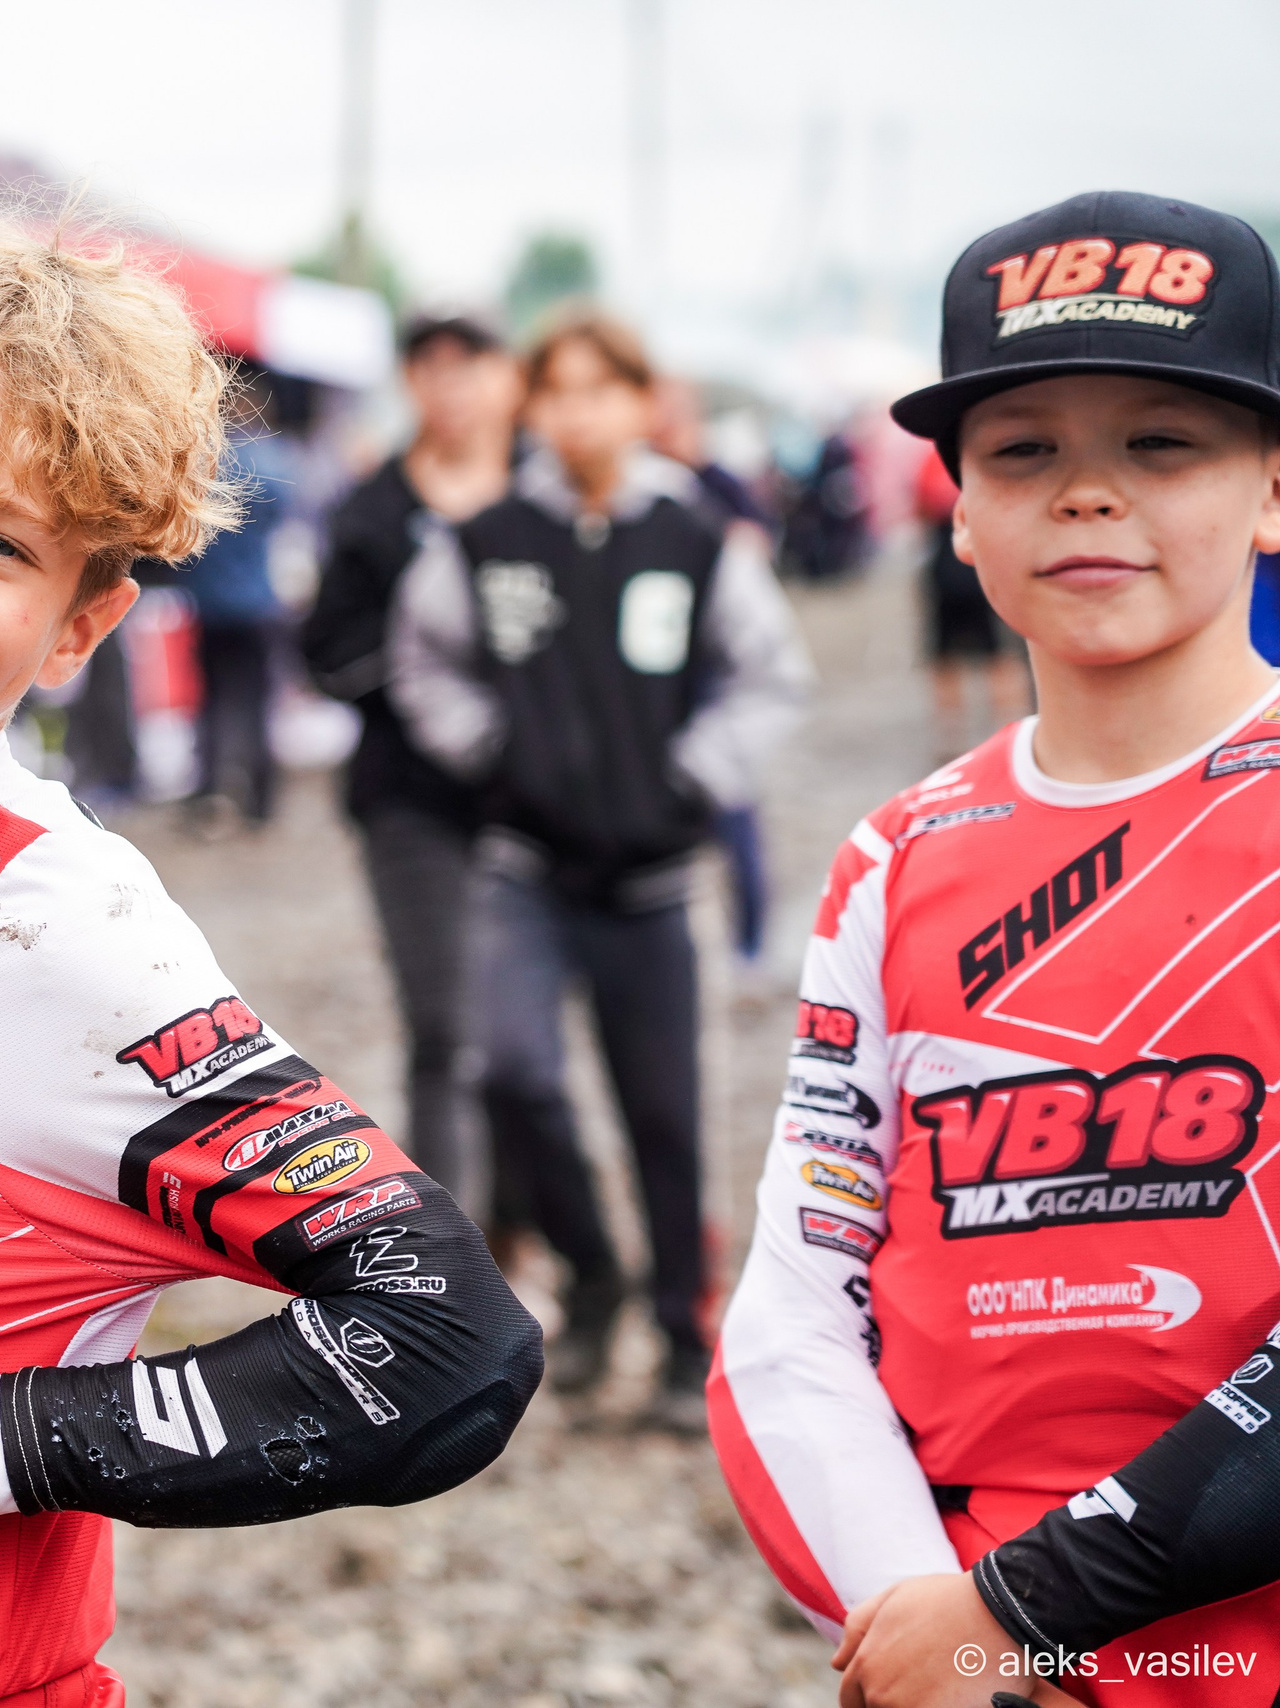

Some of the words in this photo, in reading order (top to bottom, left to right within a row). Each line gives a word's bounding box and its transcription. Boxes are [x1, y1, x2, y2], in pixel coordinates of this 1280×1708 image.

[987, 237, 1214, 310] VB18
[958, 820, 1131, 1012] SHOT
[278, 1118, 330, 1147] RACING
[916, 1066, 1254, 1186] VB18
[286, 1154, 332, 1187] Twin
[332, 1140, 359, 1166] Air
[303, 1180, 406, 1240] WRP
[312, 1225, 348, 1248] WORKS
[348, 1206, 386, 1228] RACING
[386, 1197, 417, 1212] PARTS
